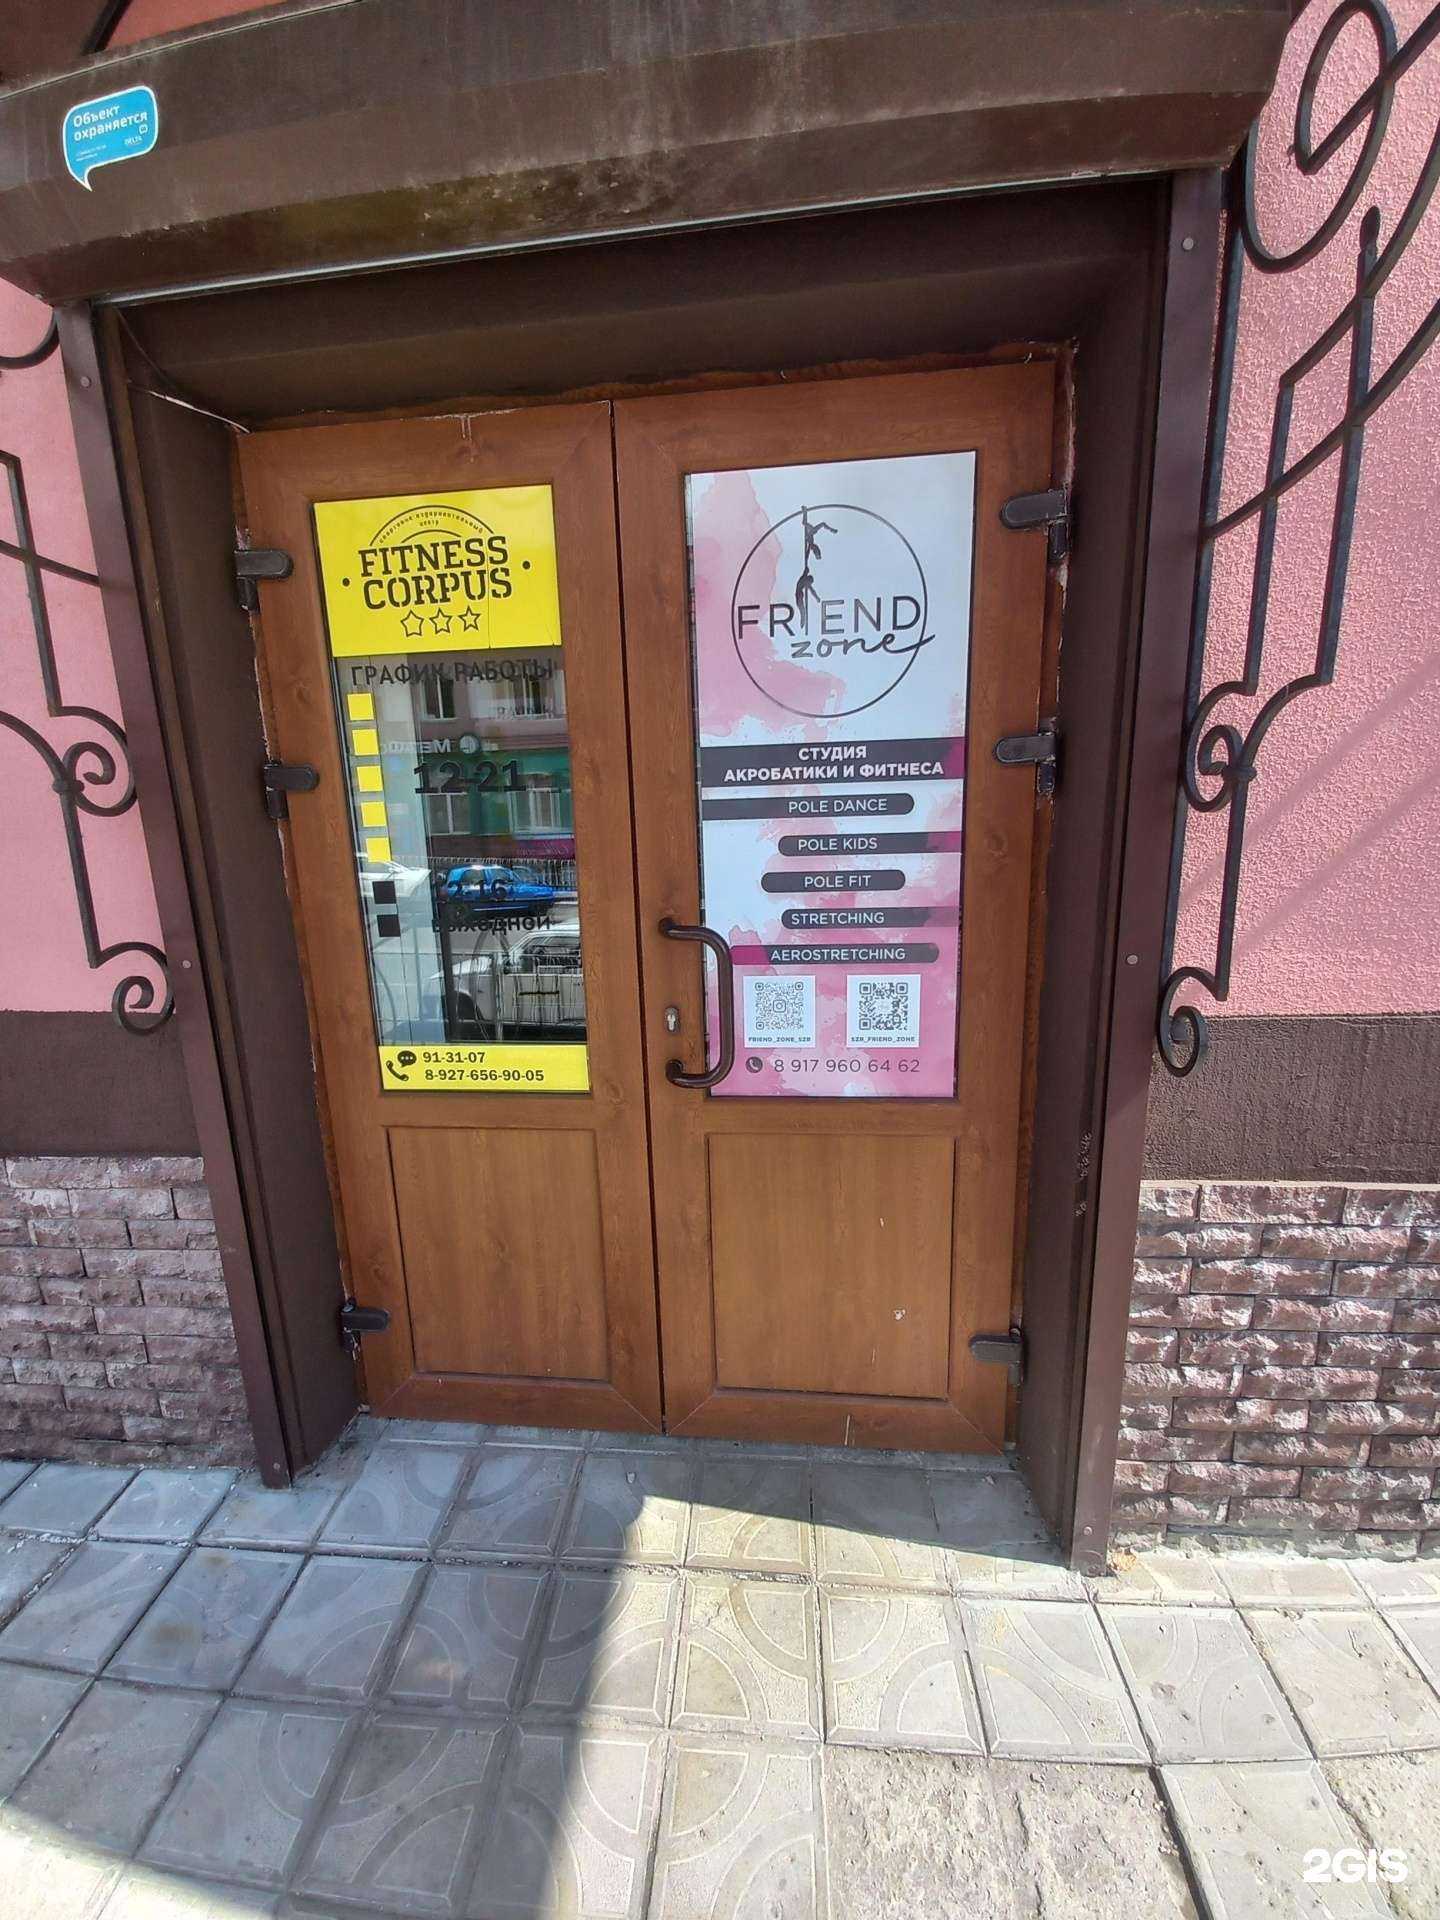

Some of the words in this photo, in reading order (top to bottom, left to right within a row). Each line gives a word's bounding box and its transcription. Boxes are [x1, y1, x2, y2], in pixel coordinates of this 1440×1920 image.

[73, 105, 120, 128] Объект
[74, 111, 148, 141] охраняется
[358, 535, 508, 577] FITNESS
[363, 567, 512, 610] CORPUS
[737, 595, 922, 639] FRIEND
[791, 632, 936, 658] zone
[351, 662, 444, 686] ГРАФИК
[454, 658, 555, 682] РАБОТЫ
[798, 745, 867, 761] СТУДИЯ
[414, 760, 526, 794] 12-21
[724, 765, 838, 782] АКРОБАТИКИ
[843, 764, 855, 778] И
[859, 761, 944, 778] ФИТНЕСА
[788, 800, 828, 813] POLE
[833, 798, 888, 812] DANCE
[798, 838, 838, 851] POLE
[843, 837, 878, 850] KIDS
[804, 875, 844, 888] POLE
[849, 874, 871, 887] FIT
[791, 911, 885, 925] STRETCHING
[771, 947, 906, 961] AEROSTRETCHING
[422, 1051, 486, 1063] 91-31-07
[774, 1059, 785, 1073] 8
[791, 1059, 819, 1073] 917
[826, 1059, 860, 1073] 960
[868, 1059, 891, 1073] 64
[898, 1059, 920, 1073] 62
[424, 1069, 544, 1081] 8-927-656-90-05
